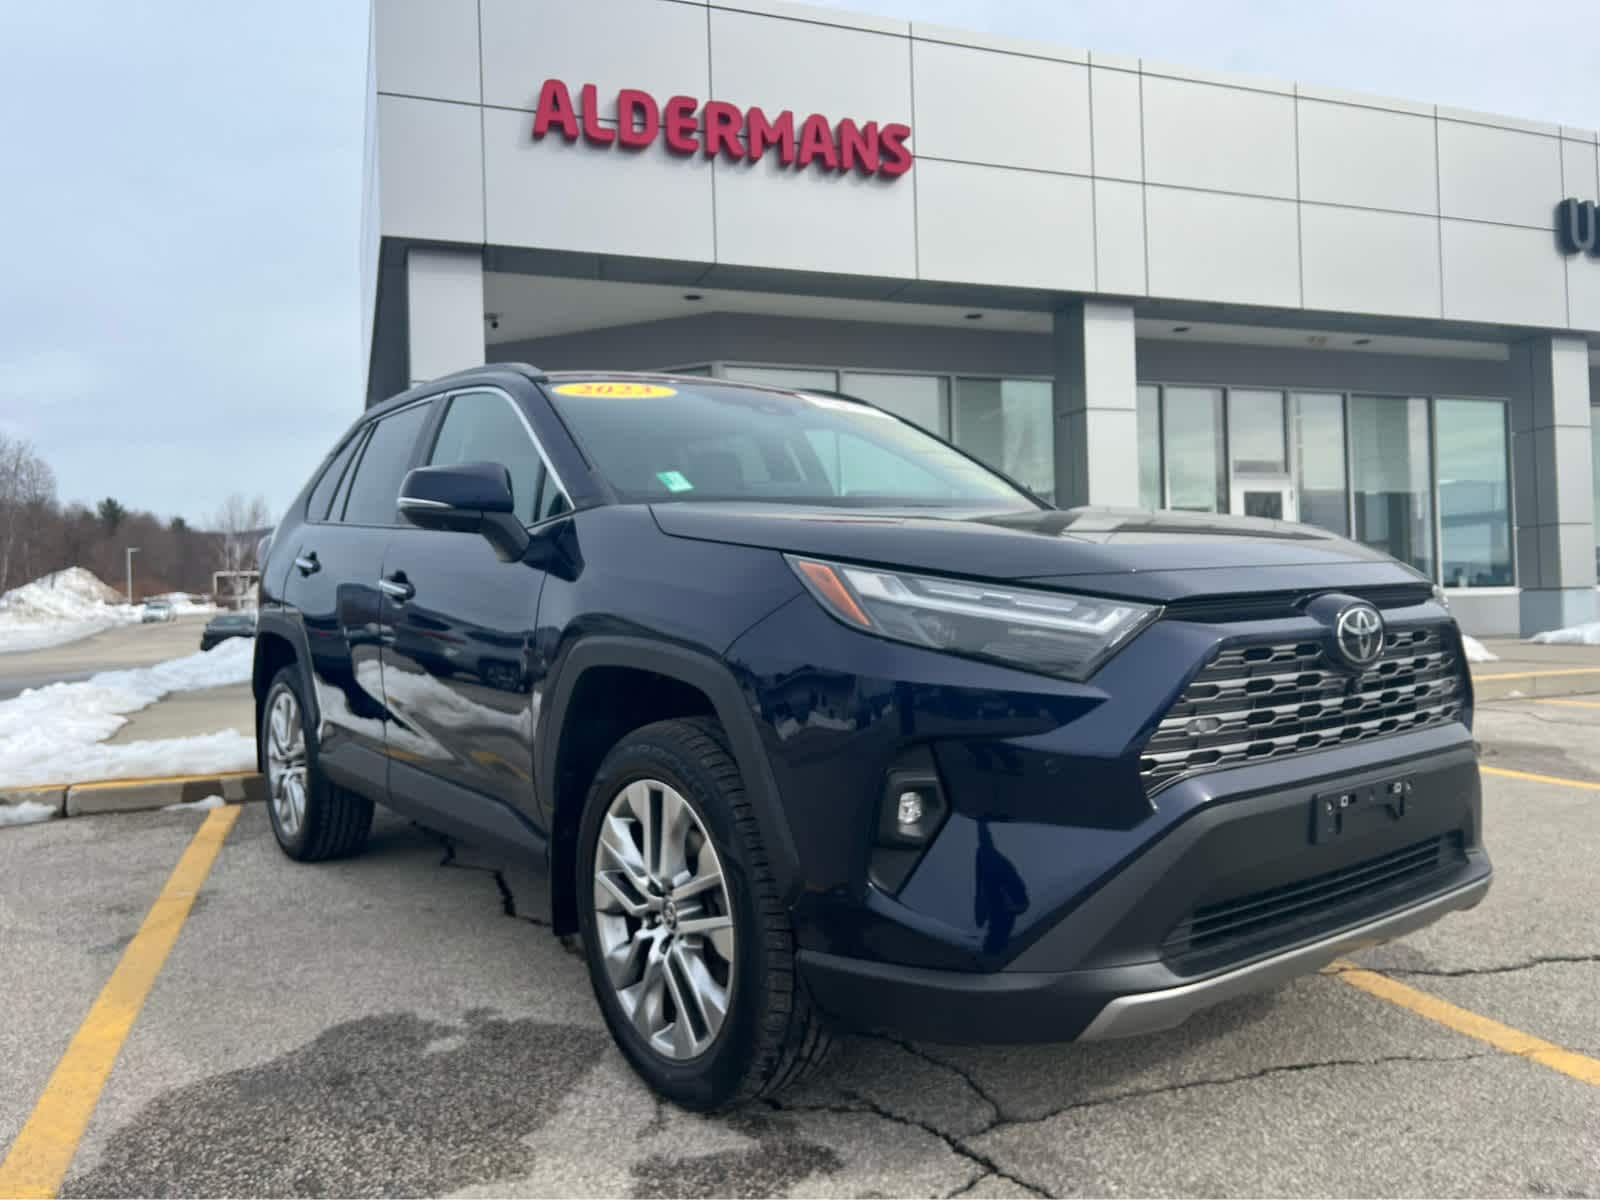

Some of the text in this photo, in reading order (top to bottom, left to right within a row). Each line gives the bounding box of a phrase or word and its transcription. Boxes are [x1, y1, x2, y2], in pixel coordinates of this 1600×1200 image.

[533, 79, 913, 179] ALDERMANS
[1553, 197, 1600, 258] U
[576, 383, 654, 396] 2023
